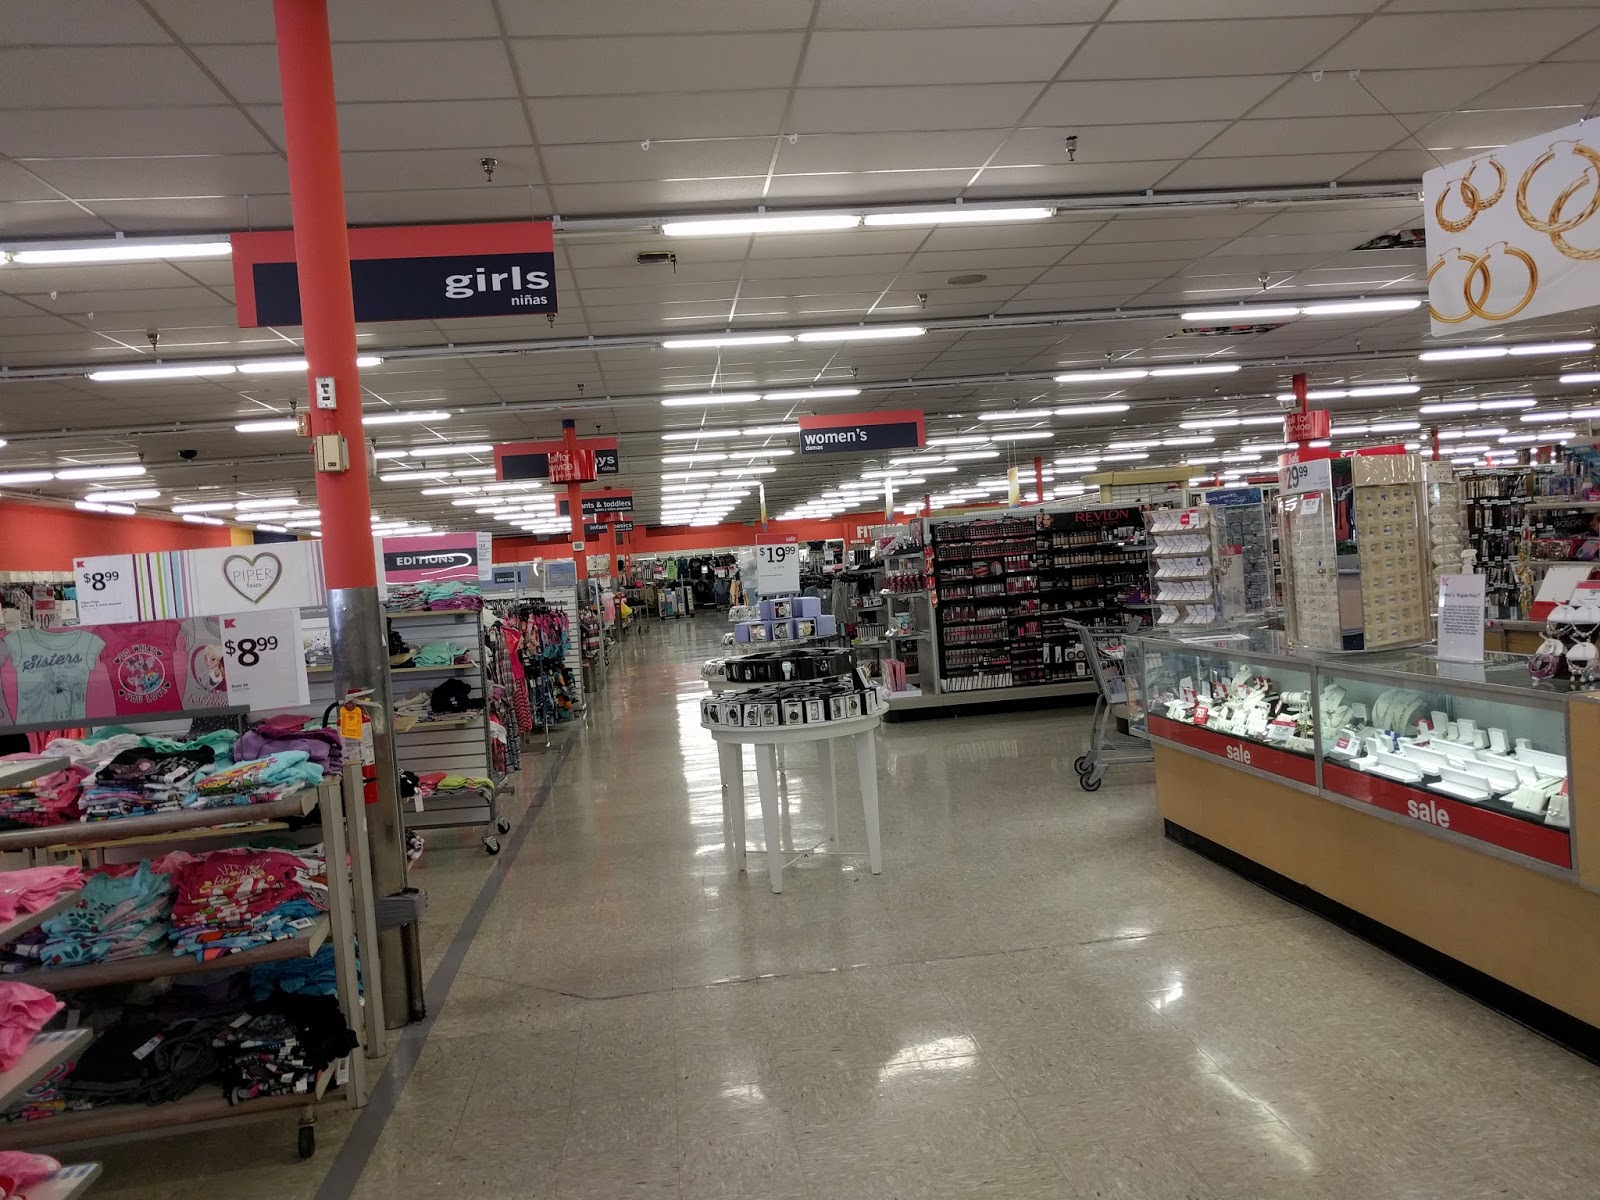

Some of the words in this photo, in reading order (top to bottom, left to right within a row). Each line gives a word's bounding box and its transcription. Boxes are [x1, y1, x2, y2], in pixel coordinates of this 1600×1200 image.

[445, 266, 550, 299] girls
[511, 294, 548, 306] niñas
[804, 428, 868, 445] women's
[603, 500, 631, 508] toddlers
[1074, 509, 1129, 523] REVLON
[396, 555, 455, 566] EDITIONS
[233, 568, 274, 583] PIPER
[22, 652, 83, 672] Sisters
[125, 693, 143, 704] YOU
[146, 686, 167, 703] LOVE
[1226, 744, 1251, 765] sale
[1407, 799, 1450, 828] sale
